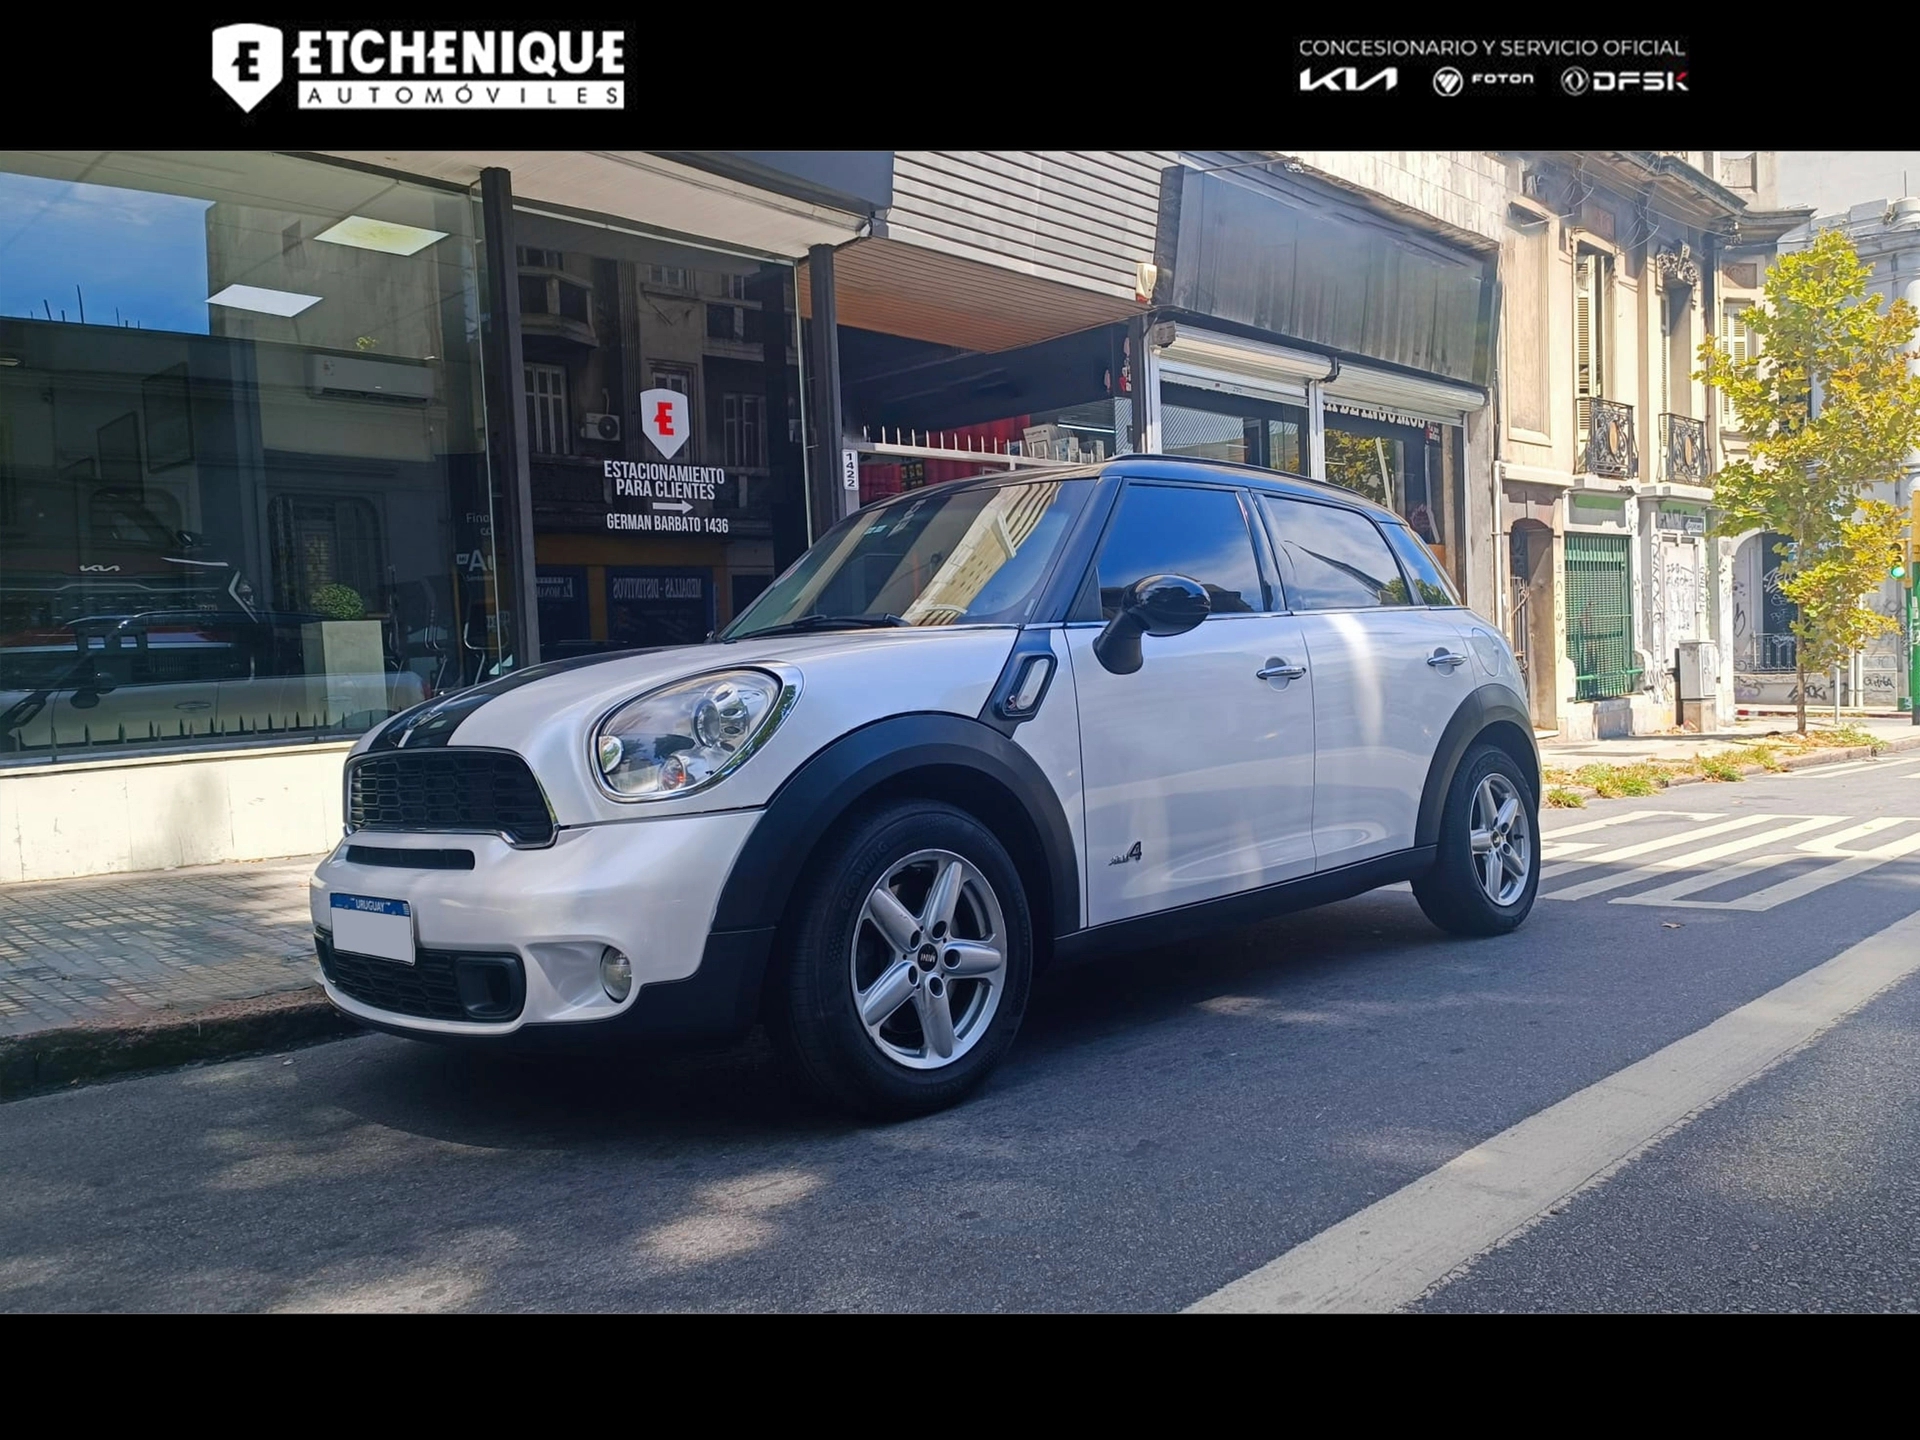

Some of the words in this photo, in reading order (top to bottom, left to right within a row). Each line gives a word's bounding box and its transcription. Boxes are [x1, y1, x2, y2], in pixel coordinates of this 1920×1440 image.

[603, 460, 726, 485] ESTACIONAMIENTO
[845, 452, 856, 488] 1422
[616, 478, 653, 497] PARA
[655, 480, 716, 500] CLIENTES
[606, 513, 652, 531] GERMAN
[654, 515, 701, 532] BARBATO
[703, 517, 729, 534] 1436
[355, 899, 385, 912] URUGUAY
